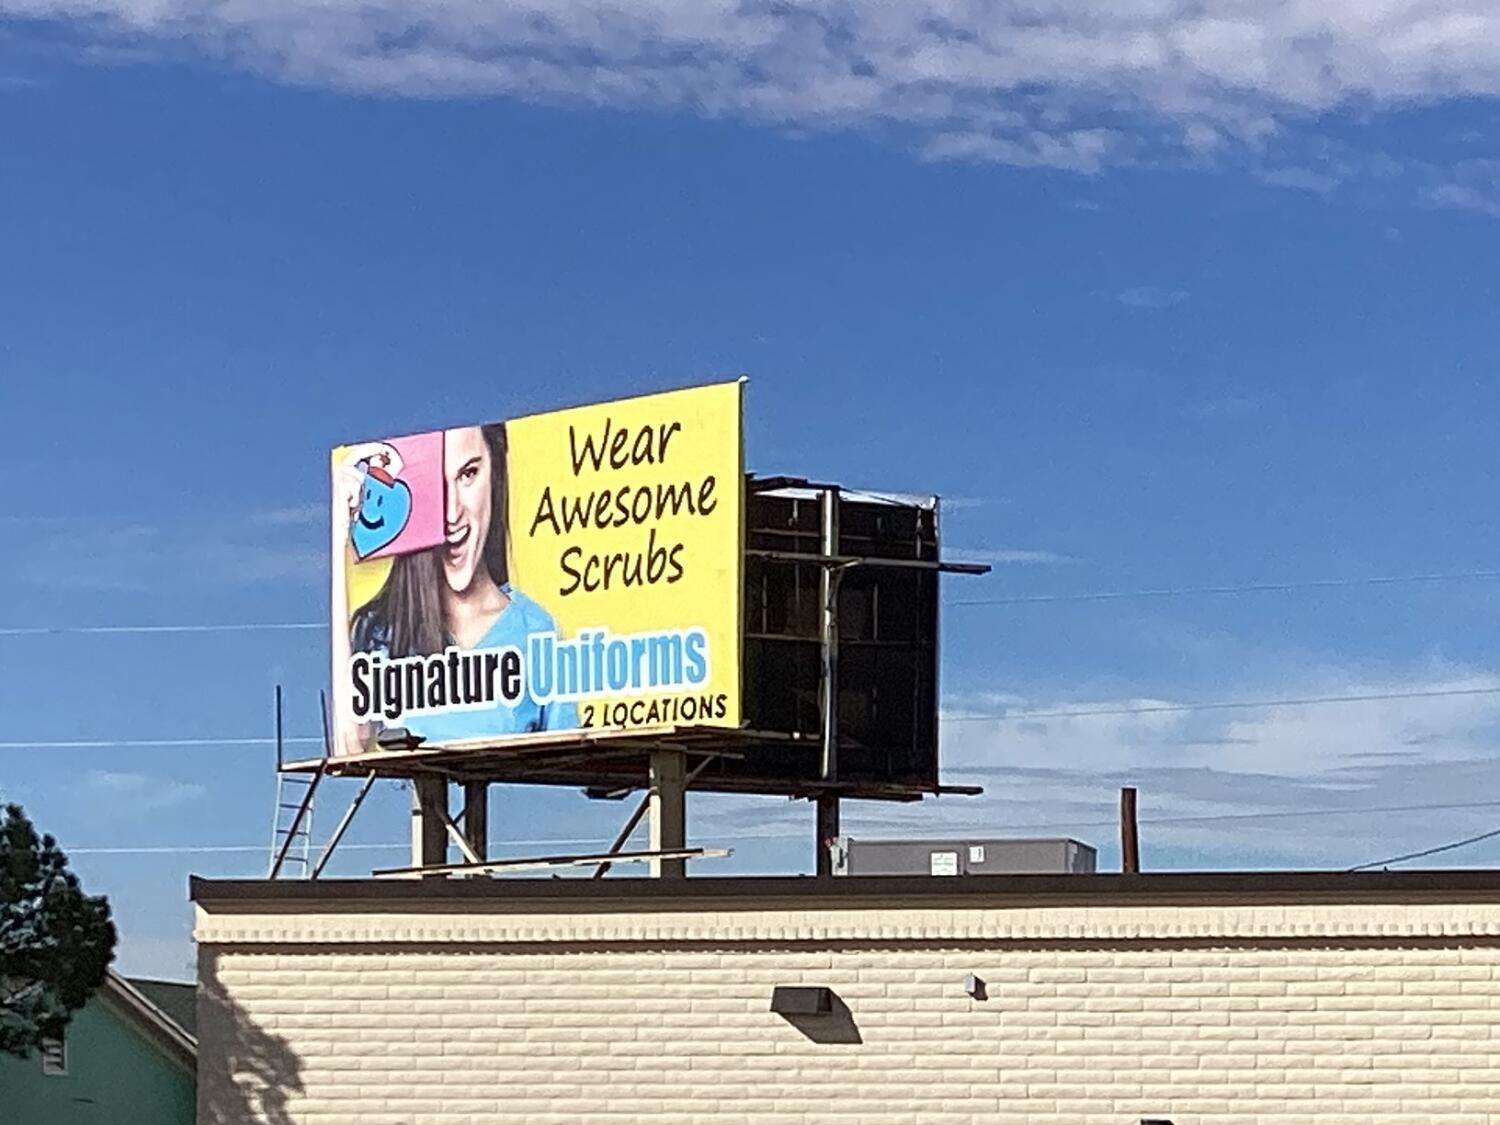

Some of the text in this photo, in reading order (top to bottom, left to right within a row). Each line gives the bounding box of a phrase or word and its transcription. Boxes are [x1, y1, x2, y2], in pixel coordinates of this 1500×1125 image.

[567, 417, 682, 477] Wear
[528, 474, 718, 537] Awesome
[558, 528, 685, 597] Scrubs
[352, 633, 706, 719] Signature Uniforms
[583, 694, 727, 729] 2 LOCATIONS
